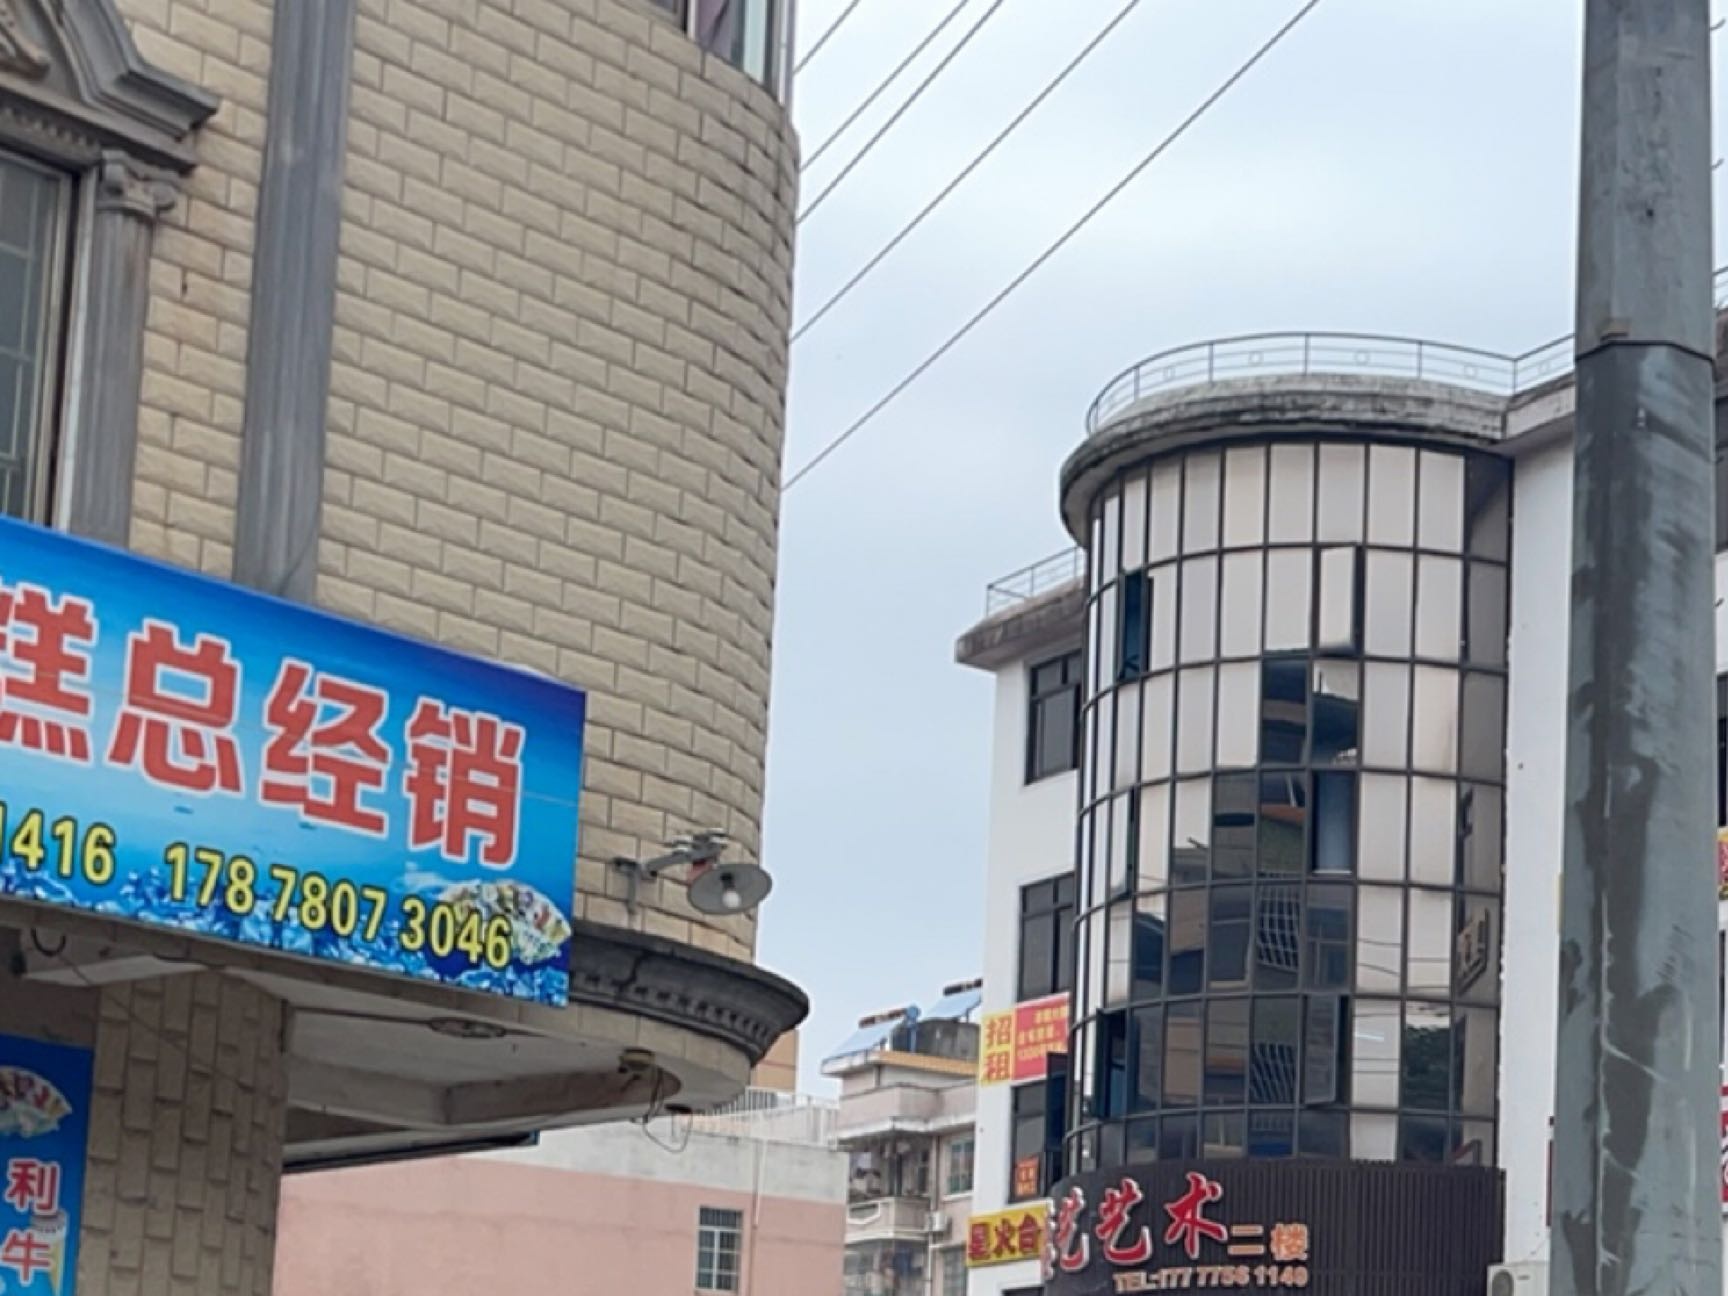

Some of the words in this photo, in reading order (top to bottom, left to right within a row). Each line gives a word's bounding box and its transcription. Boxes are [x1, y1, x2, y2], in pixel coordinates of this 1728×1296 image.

[165, 841, 255, 914] 178
[271, 866, 389, 943] 7807
[401, 896, 512, 968] 3046
[1228, 1222, 1310, 1261] 二楼
